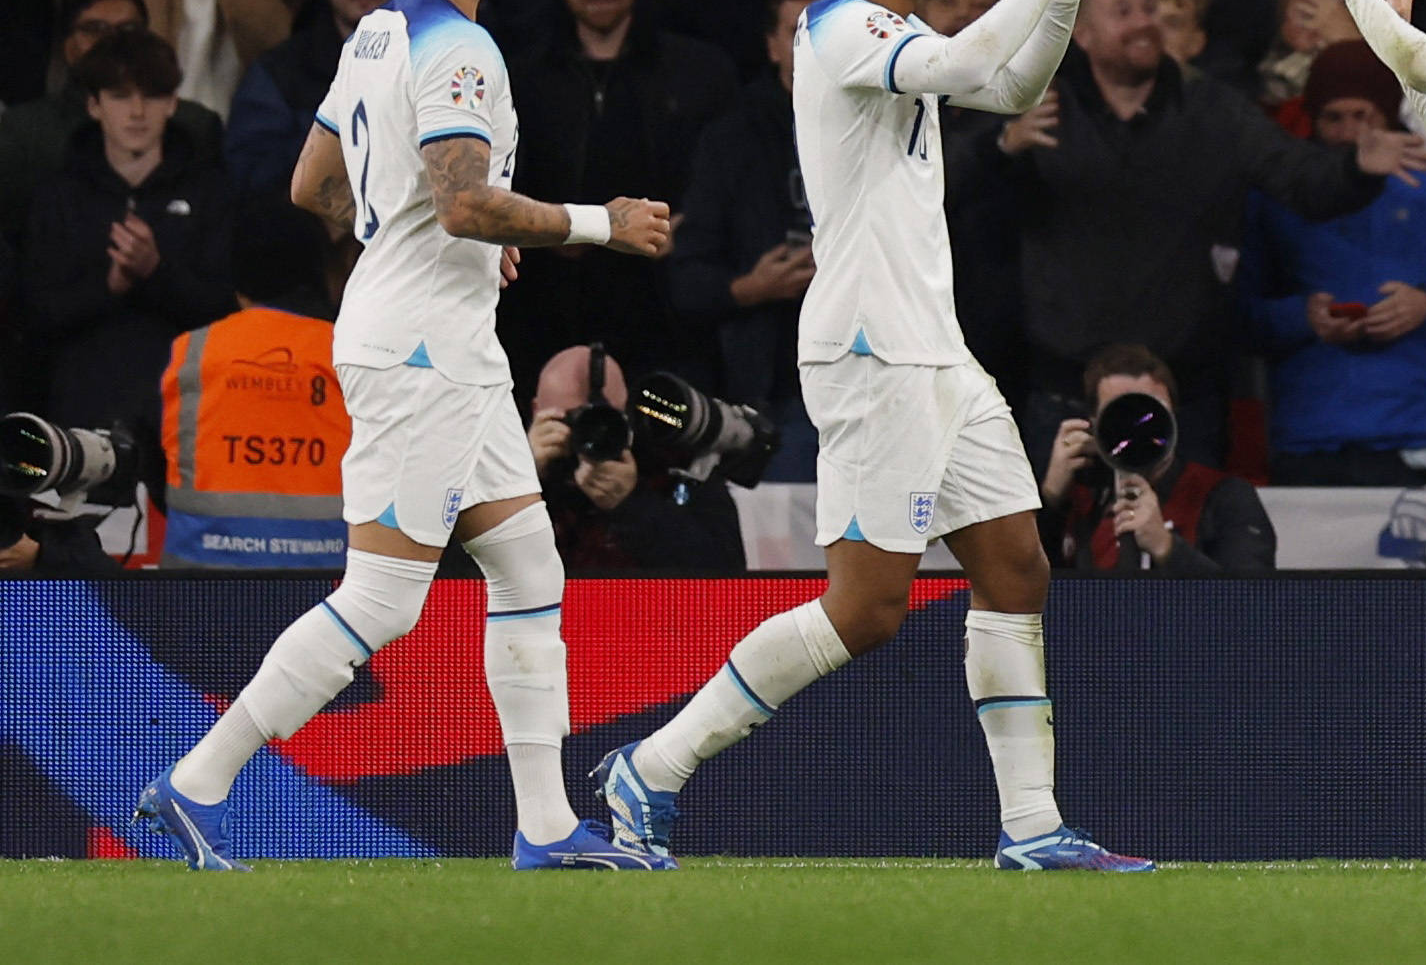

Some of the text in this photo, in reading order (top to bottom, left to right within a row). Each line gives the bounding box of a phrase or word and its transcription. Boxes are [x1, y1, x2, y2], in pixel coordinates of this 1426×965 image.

[352, 97, 380, 239] 2
[311, 376, 325, 406] 8
[222, 435, 326, 466] TS370
[202, 534, 344, 554] SEARCH STEWARD
